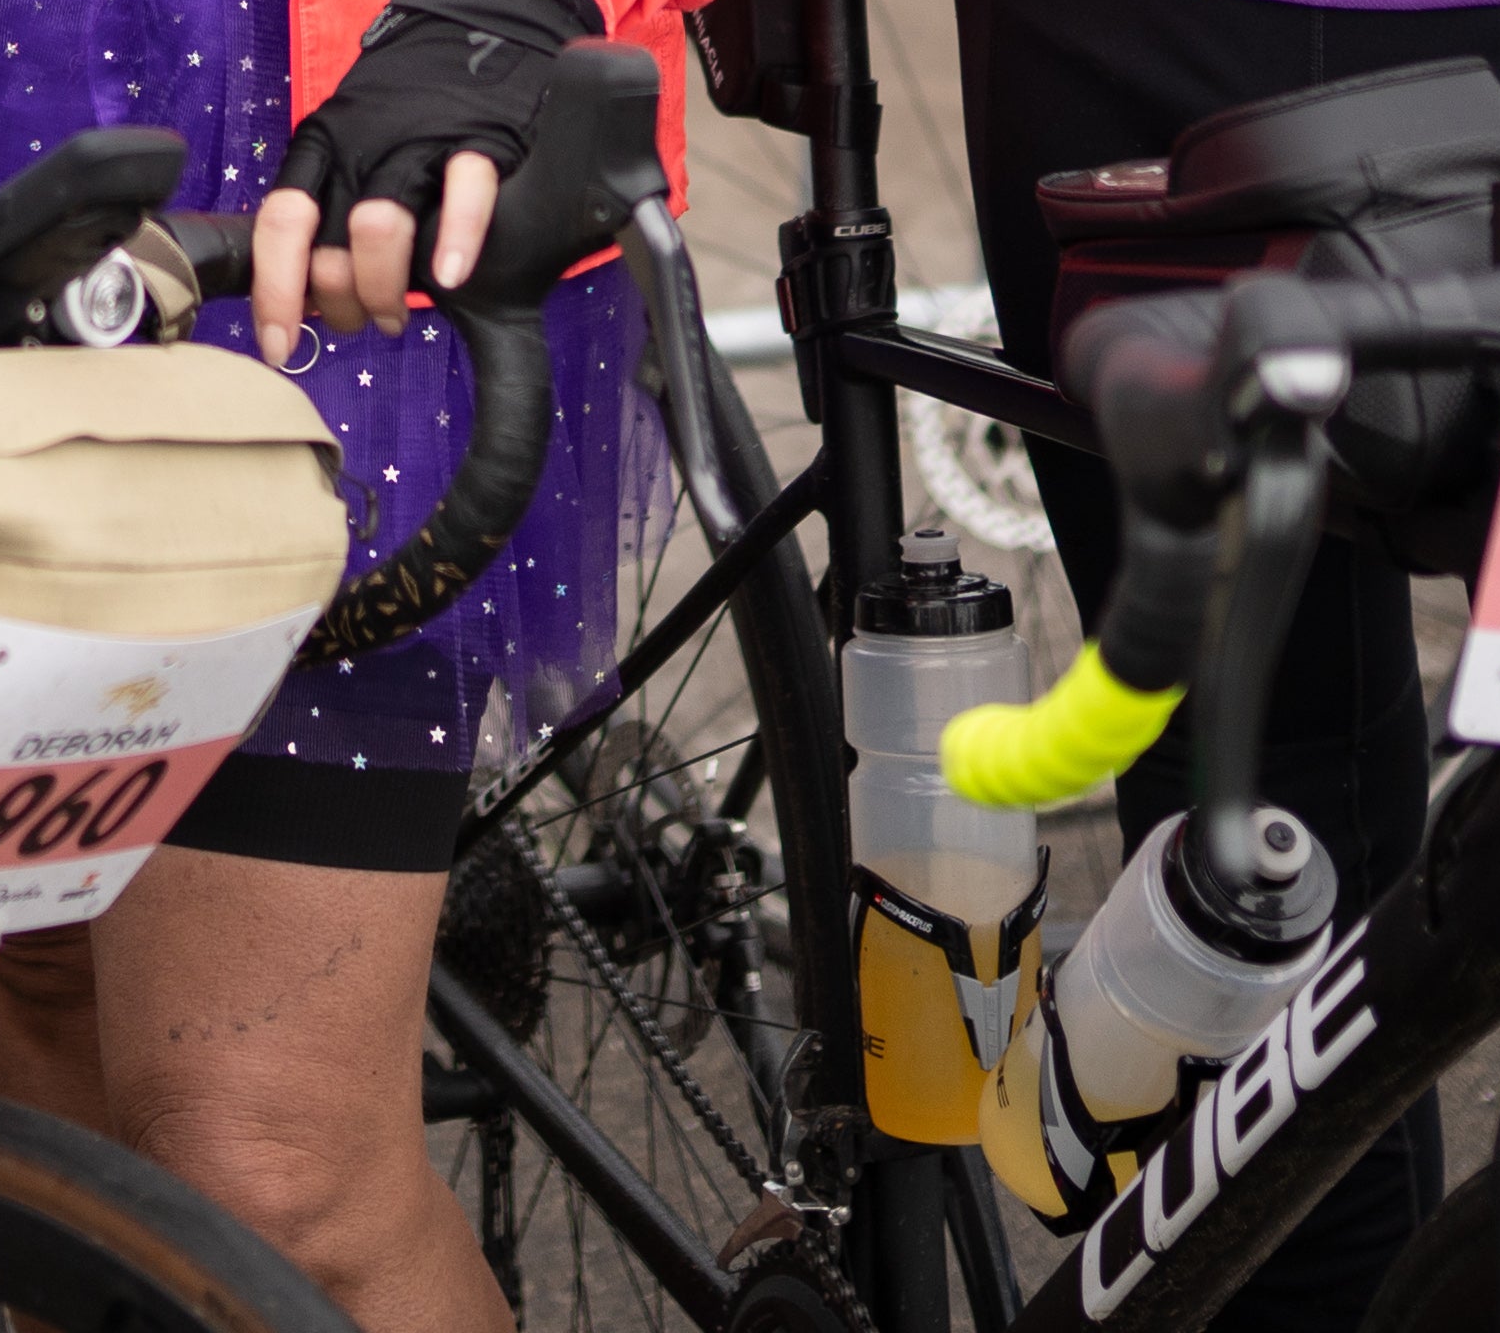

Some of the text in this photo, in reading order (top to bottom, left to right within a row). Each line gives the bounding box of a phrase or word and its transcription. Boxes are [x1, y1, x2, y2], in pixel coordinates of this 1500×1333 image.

[834, 223, 887, 237] CUBE
[12, 719, 180, 763] DEBORAH
[1081, 916, 1377, 1321] CUBE
